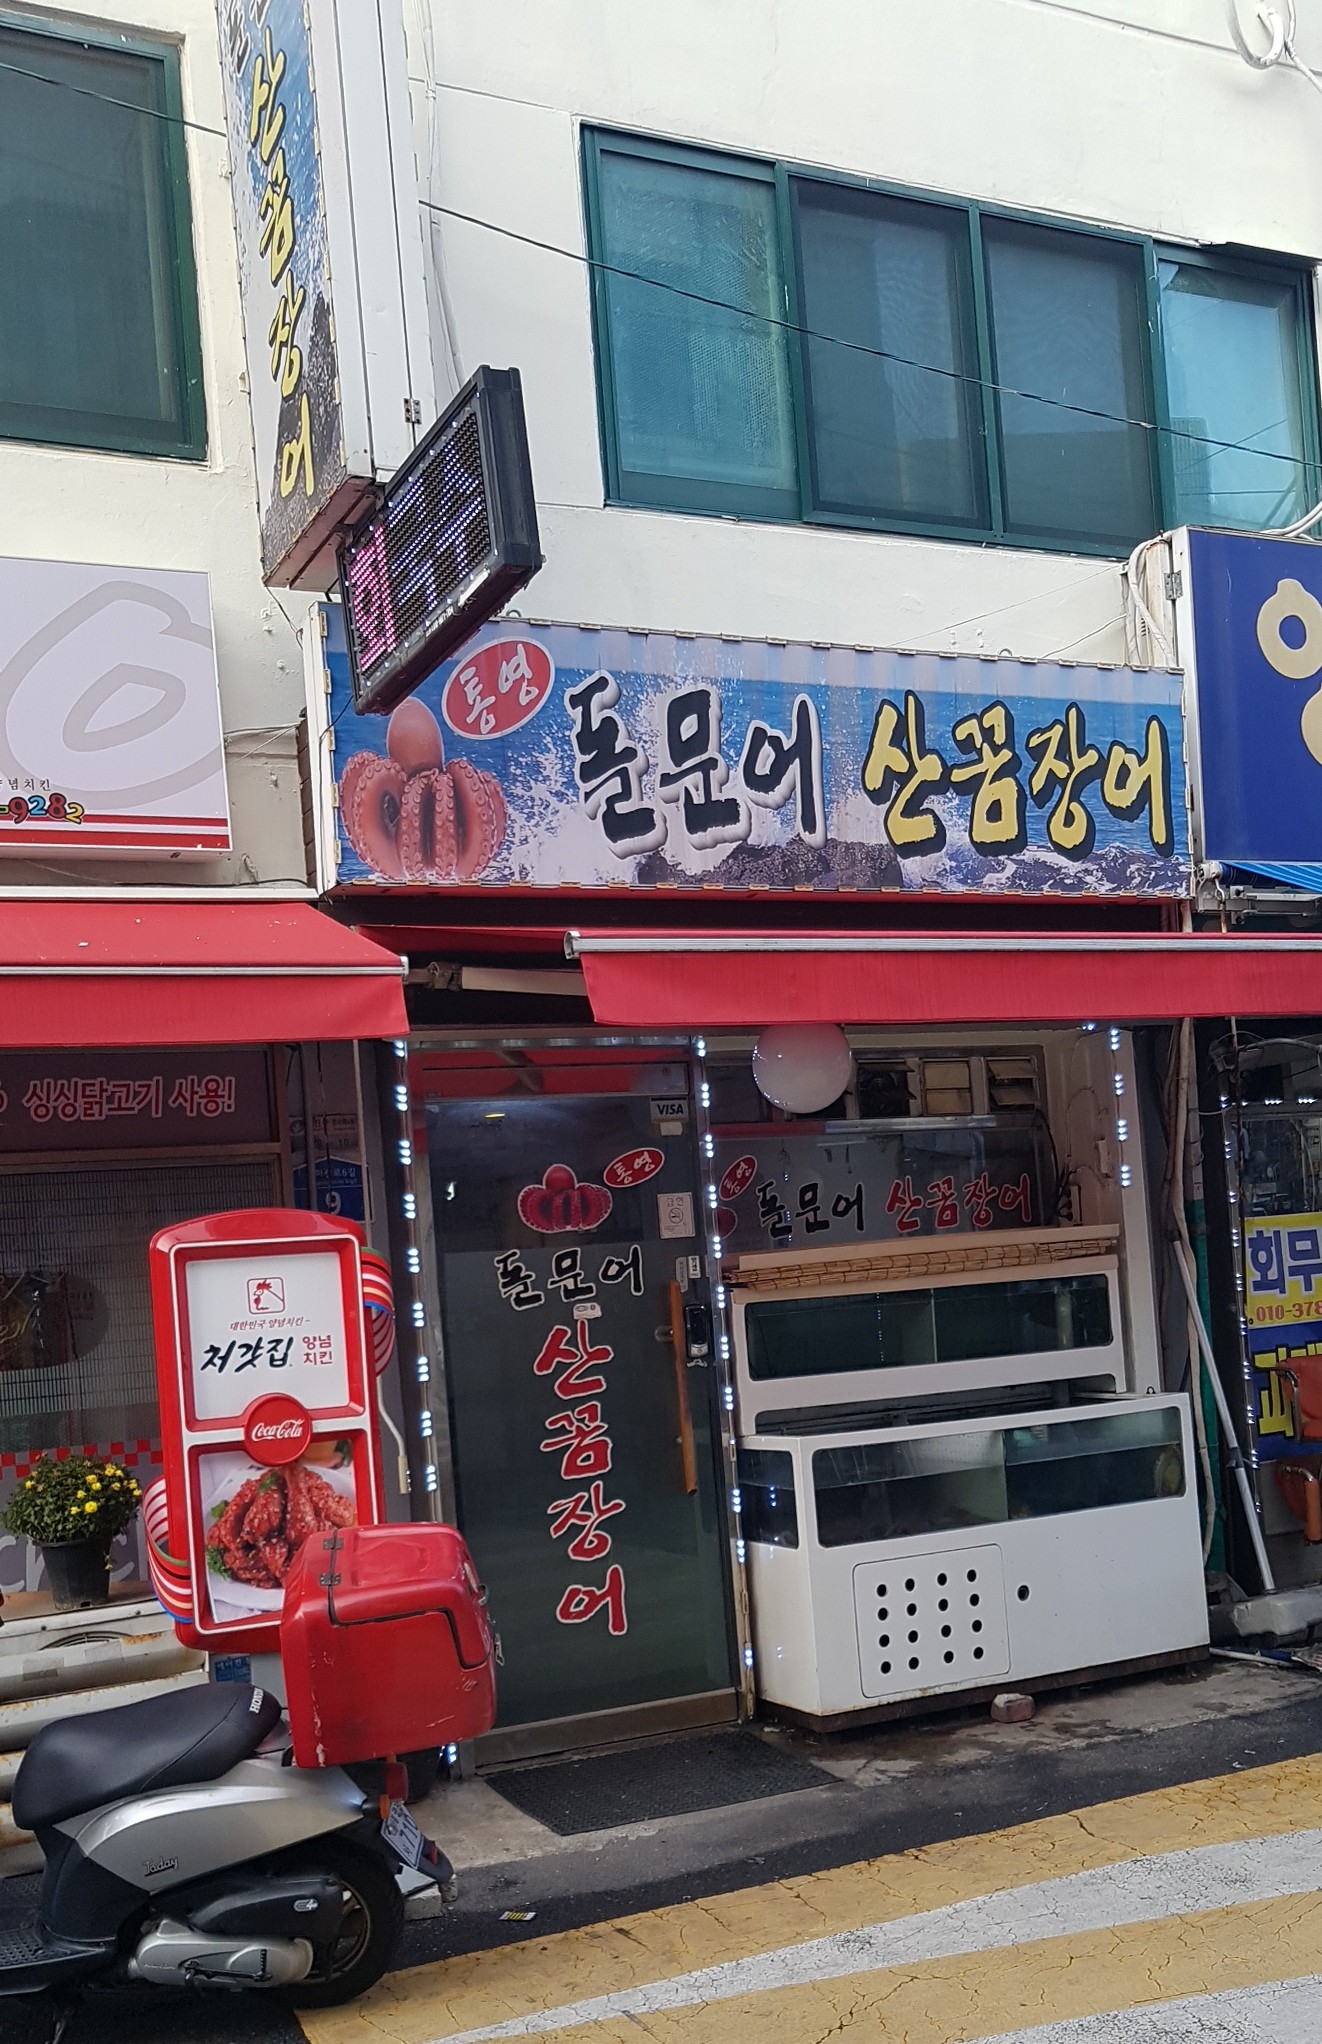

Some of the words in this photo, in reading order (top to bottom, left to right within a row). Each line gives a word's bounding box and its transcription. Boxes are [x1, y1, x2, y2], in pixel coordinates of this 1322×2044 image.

[459, 643, 540, 735] 통영
[0, 777, 51, 792] 념치킨
[567, 673, 822, 852] 돌문어
[863, 691, 1172, 858] 산꼼장어
[23, 1077, 163, 1122] 싱싱닭고기
[169, 1075, 236, 1118] 사용!
[657, 1104, 684, 1116] VISA
[756, 1179, 865, 1240] 돌문어
[885, 1172, 1034, 1234] 산꼼장어
[494, 1243, 645, 1312] 돌문어
[200, 1336, 294, 1374] 처갓집
[302, 1334, 332, 1350] 양념
[303, 1351, 333, 1366] 치킨
[533, 1318, 627, 1637] 산꼼장어
